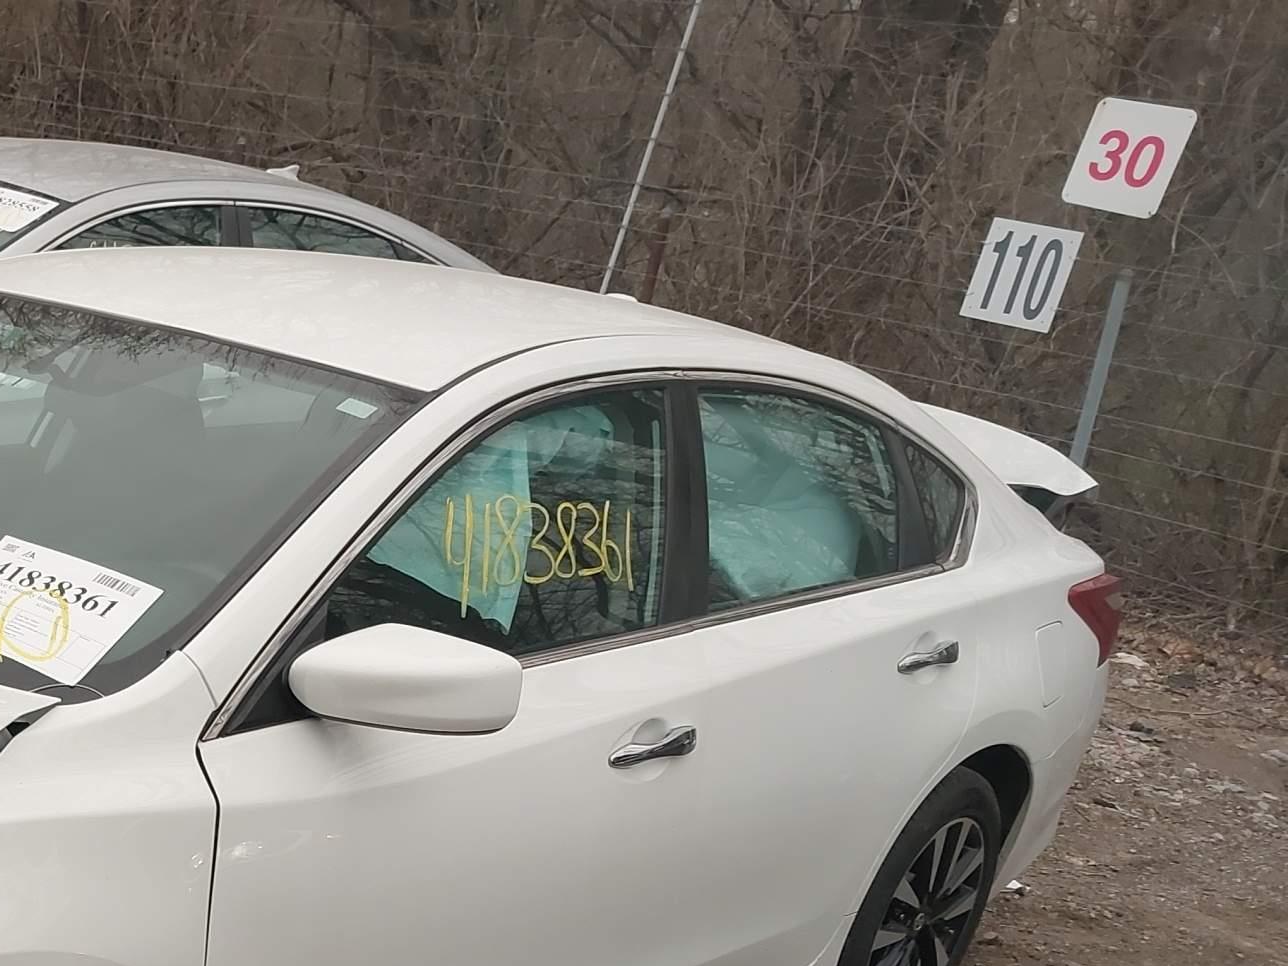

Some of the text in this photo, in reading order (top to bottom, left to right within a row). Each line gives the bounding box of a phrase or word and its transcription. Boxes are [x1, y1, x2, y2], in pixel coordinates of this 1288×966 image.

[1087, 129, 1166, 189] 30
[979, 229, 1065, 323] 110
[446, 493, 635, 619] 41838361
